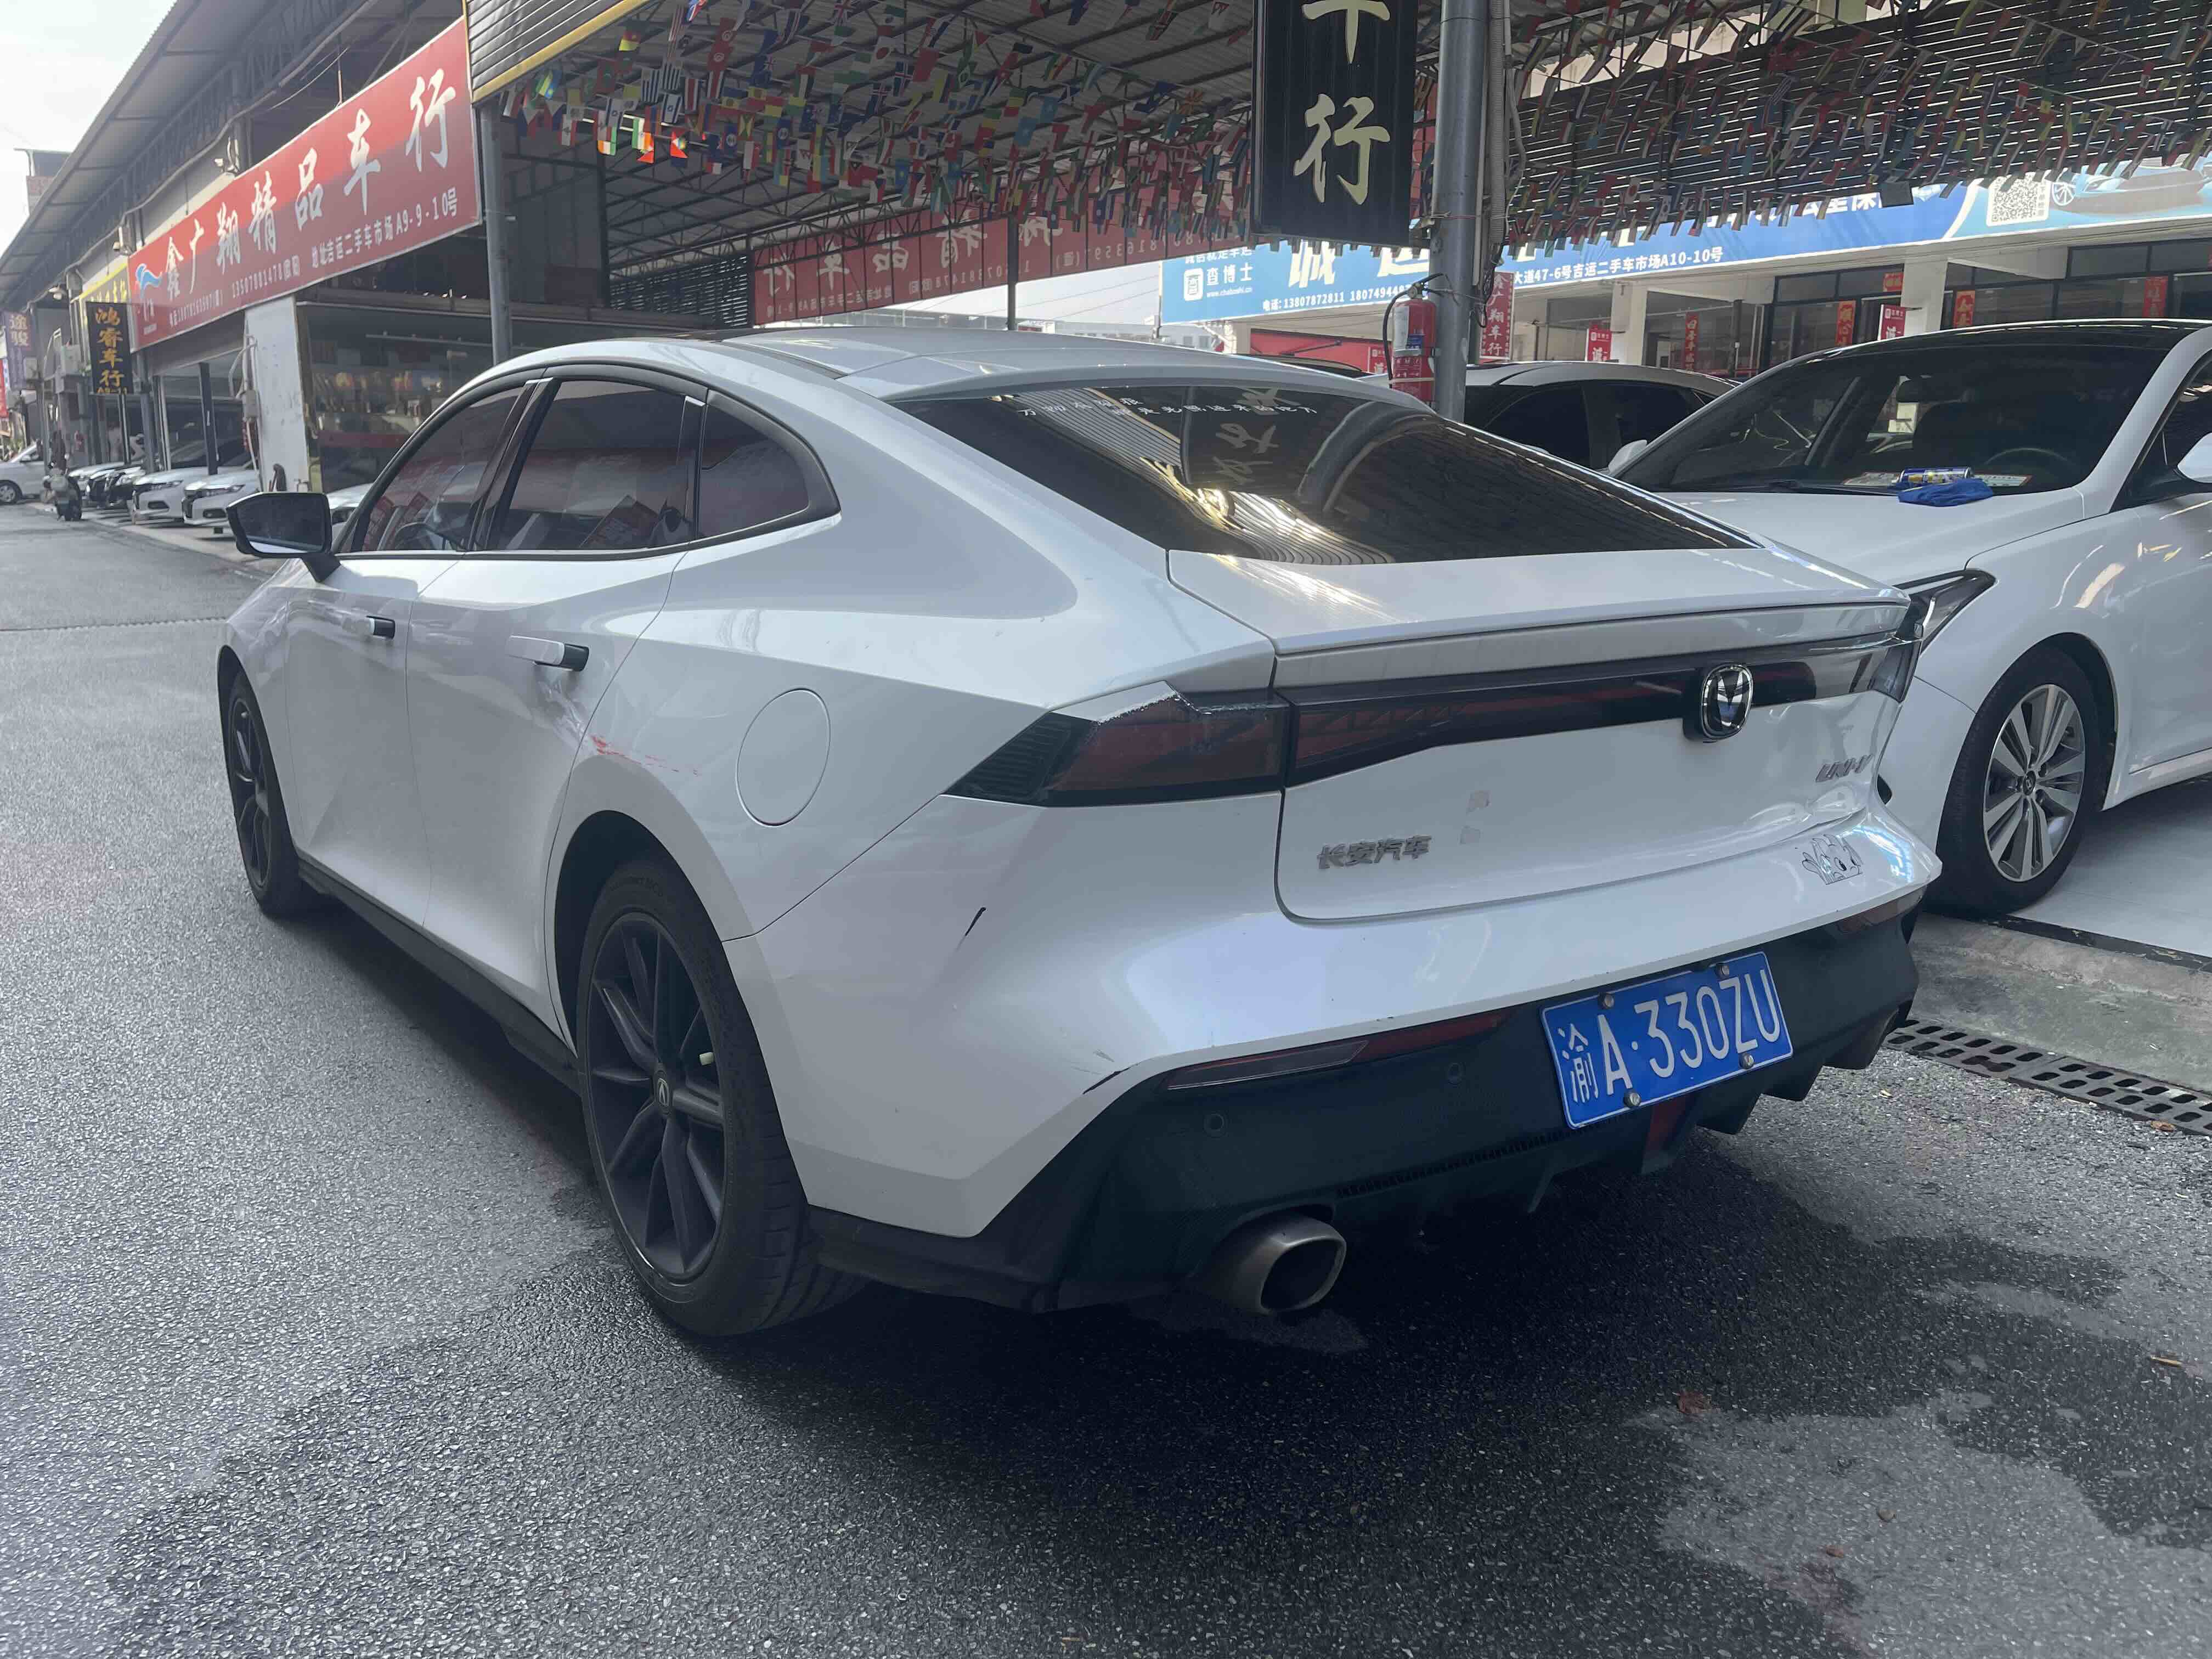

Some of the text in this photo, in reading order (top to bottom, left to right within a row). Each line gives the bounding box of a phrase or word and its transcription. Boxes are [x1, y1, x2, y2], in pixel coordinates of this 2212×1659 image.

[1207, 262, 1253, 286] 查博士
[1317, 834, 1432, 870] 长安汽车
